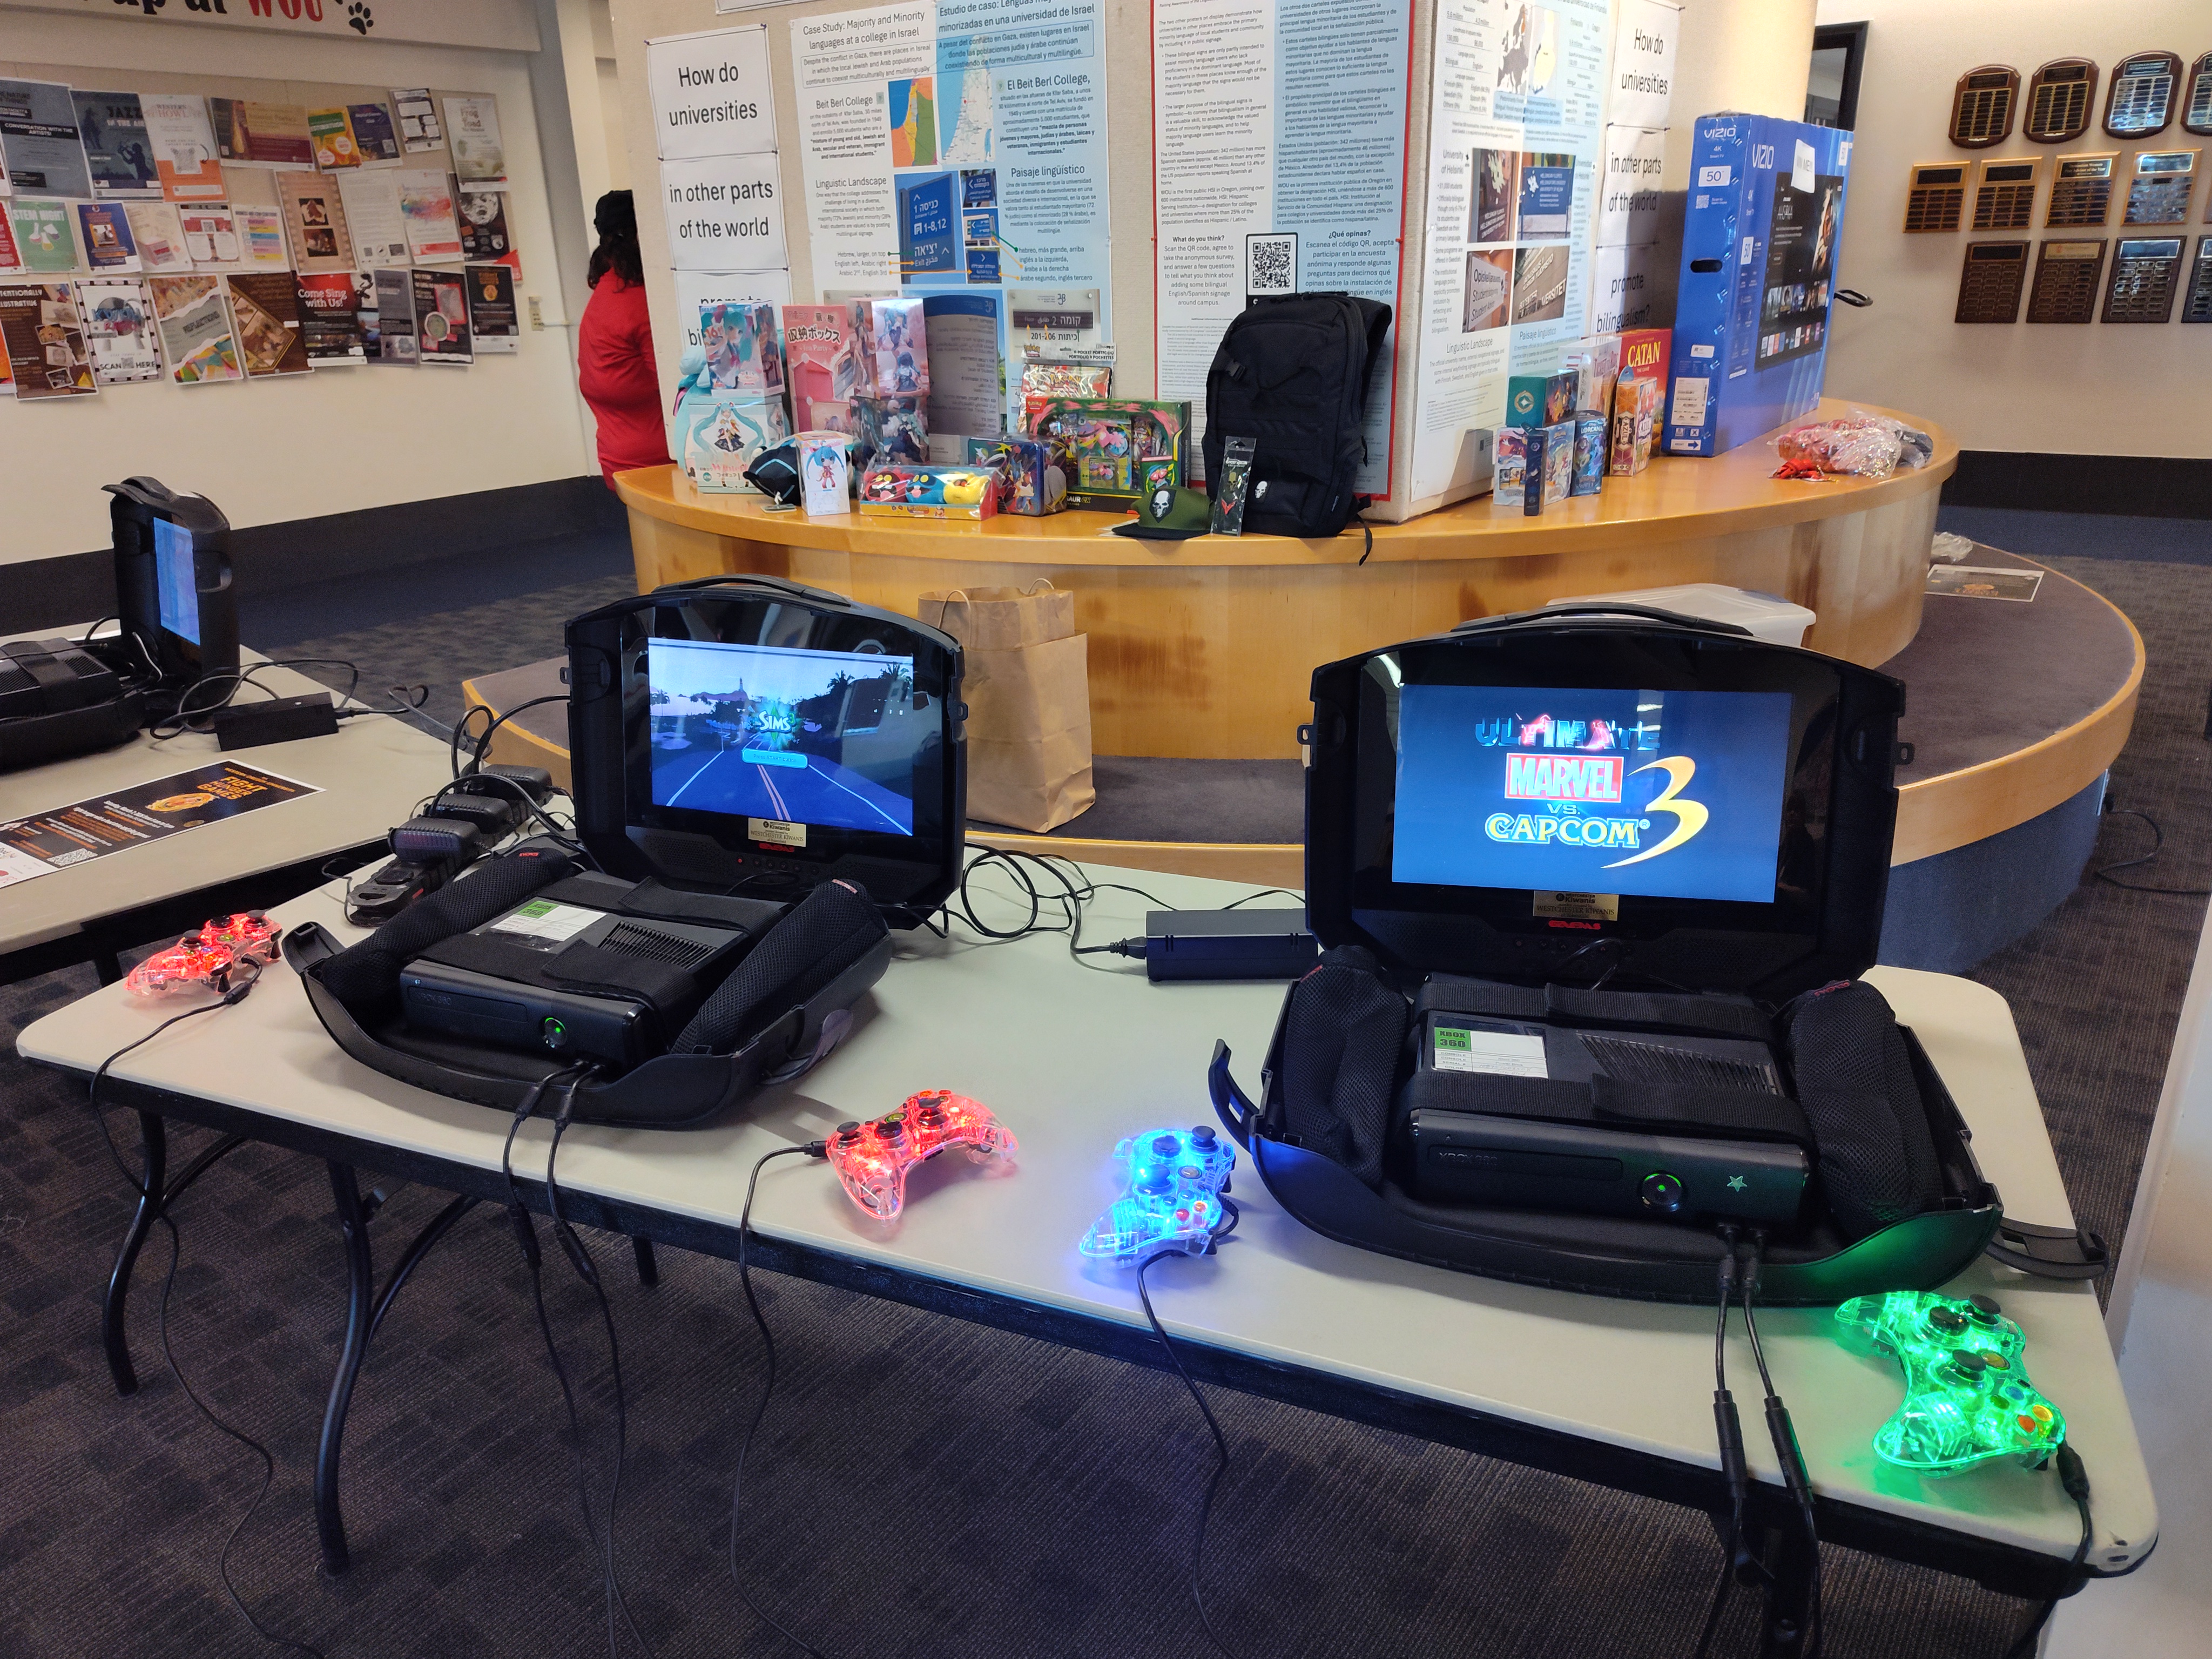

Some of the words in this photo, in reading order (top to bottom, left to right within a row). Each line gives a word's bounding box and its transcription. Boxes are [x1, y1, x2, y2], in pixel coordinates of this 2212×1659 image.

[940, 3, 966, 17] Estudio
[968, 3, 976, 12] de
[979, 1, 999, 11] caso:
[803, 25, 821, 35] Case
[822, 22, 845, 33] Study:
[847, 18, 876, 30] Majority
[878, 15, 891, 25] and
[894, 11, 925, 23] Minority
[939, 21, 982, 33] minorizadas
[995, 16, 1010, 24] una
[1011, 9, 1057, 23] universidad
[1059, 6, 1069, 16] de
[1072, 4, 1095, 15] Israel
[809, 38, 845, 50] languages
[846, 36, 854, 45] at
[861, 32, 888, 43] college
[889, 30, 896, 39] in
[898, 27, 919, 37] Israel
[1634, 28, 1654, 52] How
[1654, 33, 1663, 55] do
[678, 66, 714, 87] How
[719, 62, 739, 83] do
[1008, 80, 1015, 90] El
[1017, 78, 1033, 89] Beit
[1035, 77, 1052, 87] Berl
[1054, 75, 1090, 85] College,
[1622, 70, 1668, 95] universities
[817, 100, 829, 109] Beit
[831, 98, 844, 108] Berl
[846, 96, 873, 106] College
[669, 100, 758, 126] universities
[1704, 128, 1736, 138] VIZIO
[1752, 144, 1774, 169] VIZIO
[1011, 167, 1040, 179] Paisaje
[1042, 164, 1084, 177] lingüístico
[1611, 152, 1619, 172] in
[1621, 153, 1641, 173] other
[1642, 157, 1661, 178] parts
[816, 179, 846, 190] Linguistic
[848, 177, 887, 187] Landscape
[669, 184, 682, 203] in
[686, 183, 725, 201] other
[731, 181, 773, 205] parts
[914, 205, 918, 213] 1
[919, 200, 939, 212] כניסה
[1609, 192, 1618, 212] of
[1620, 192, 1633, 212] the
[1635, 192, 1657, 211] world
[13, 210, 37, 220] STEM
[39, 211, 65, 221] NIGHT
[680, 220, 692, 238] of
[696, 219, 721, 238] the
[725, 217, 769, 237] world
[924, 219, 947, 232] 1-8,12
[914, 243, 938, 257] יציאה
[915, 259, 925, 267] Exit
[1611, 273, 1644, 299] promote
[298, 289, 323, 298] Come
[326, 289, 347, 299] Sing
[305, 299, 327, 308] with
[328, 298, 343, 307] Us!
[1053, 316, 1056, 325] 2
[1060, 316, 1081, 326] קומה
[1597, 305, 1650, 333] bilingualism?
[788, 327, 841, 344] 収納ボックス
[1519, 331, 1536, 340] Paisaje
[1446, 342, 1469, 354] Linguistic
[1470, 338, 1493, 349] Landscape
[1628, 341, 1661, 368] CATAN
[1475, 719, 1661, 751] ULTIMATE
[1509, 757, 1617, 799] MARVEL
[1547, 803, 1581, 815] VS.
[1601, 756, 1709, 868] 3
[751, 831, 783, 839] WESTCHESTER
[1537, 905, 1584, 913] WESTCHESTER
[1439, 1030, 1466, 1038] XBOX
[1440, 1039, 1466, 1048] 360
